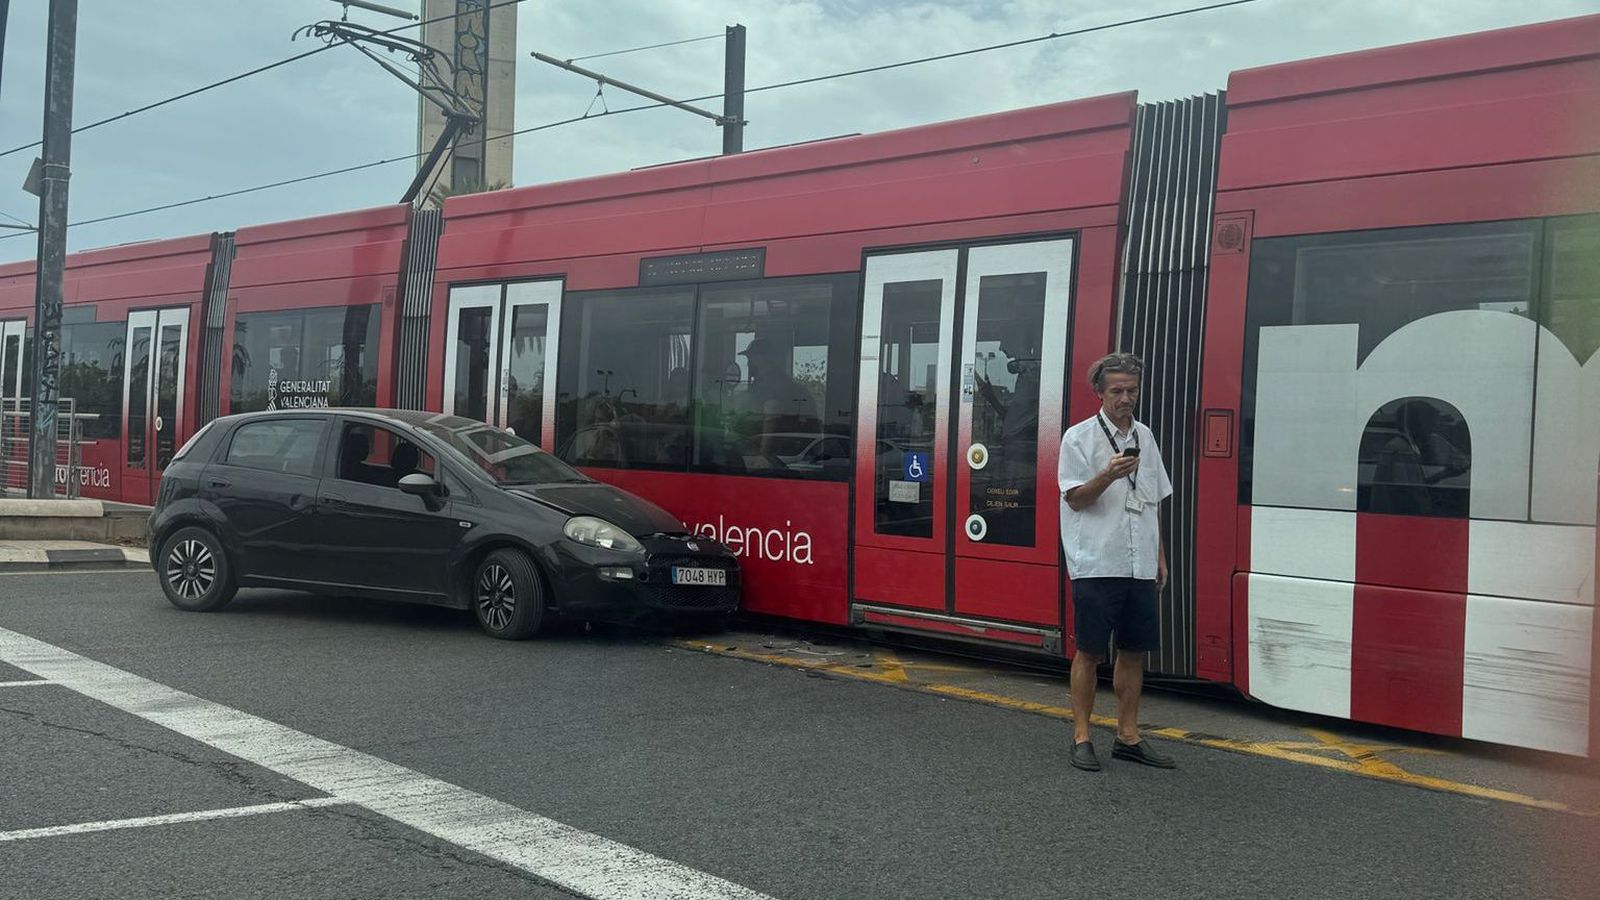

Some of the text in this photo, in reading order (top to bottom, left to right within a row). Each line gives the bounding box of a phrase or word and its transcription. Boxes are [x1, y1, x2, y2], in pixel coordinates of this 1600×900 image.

[280, 380, 331, 393] GENERALITAT
[280, 396, 329, 408] VALENCIANA
[678, 568, 725, 584] 7048 HYP
